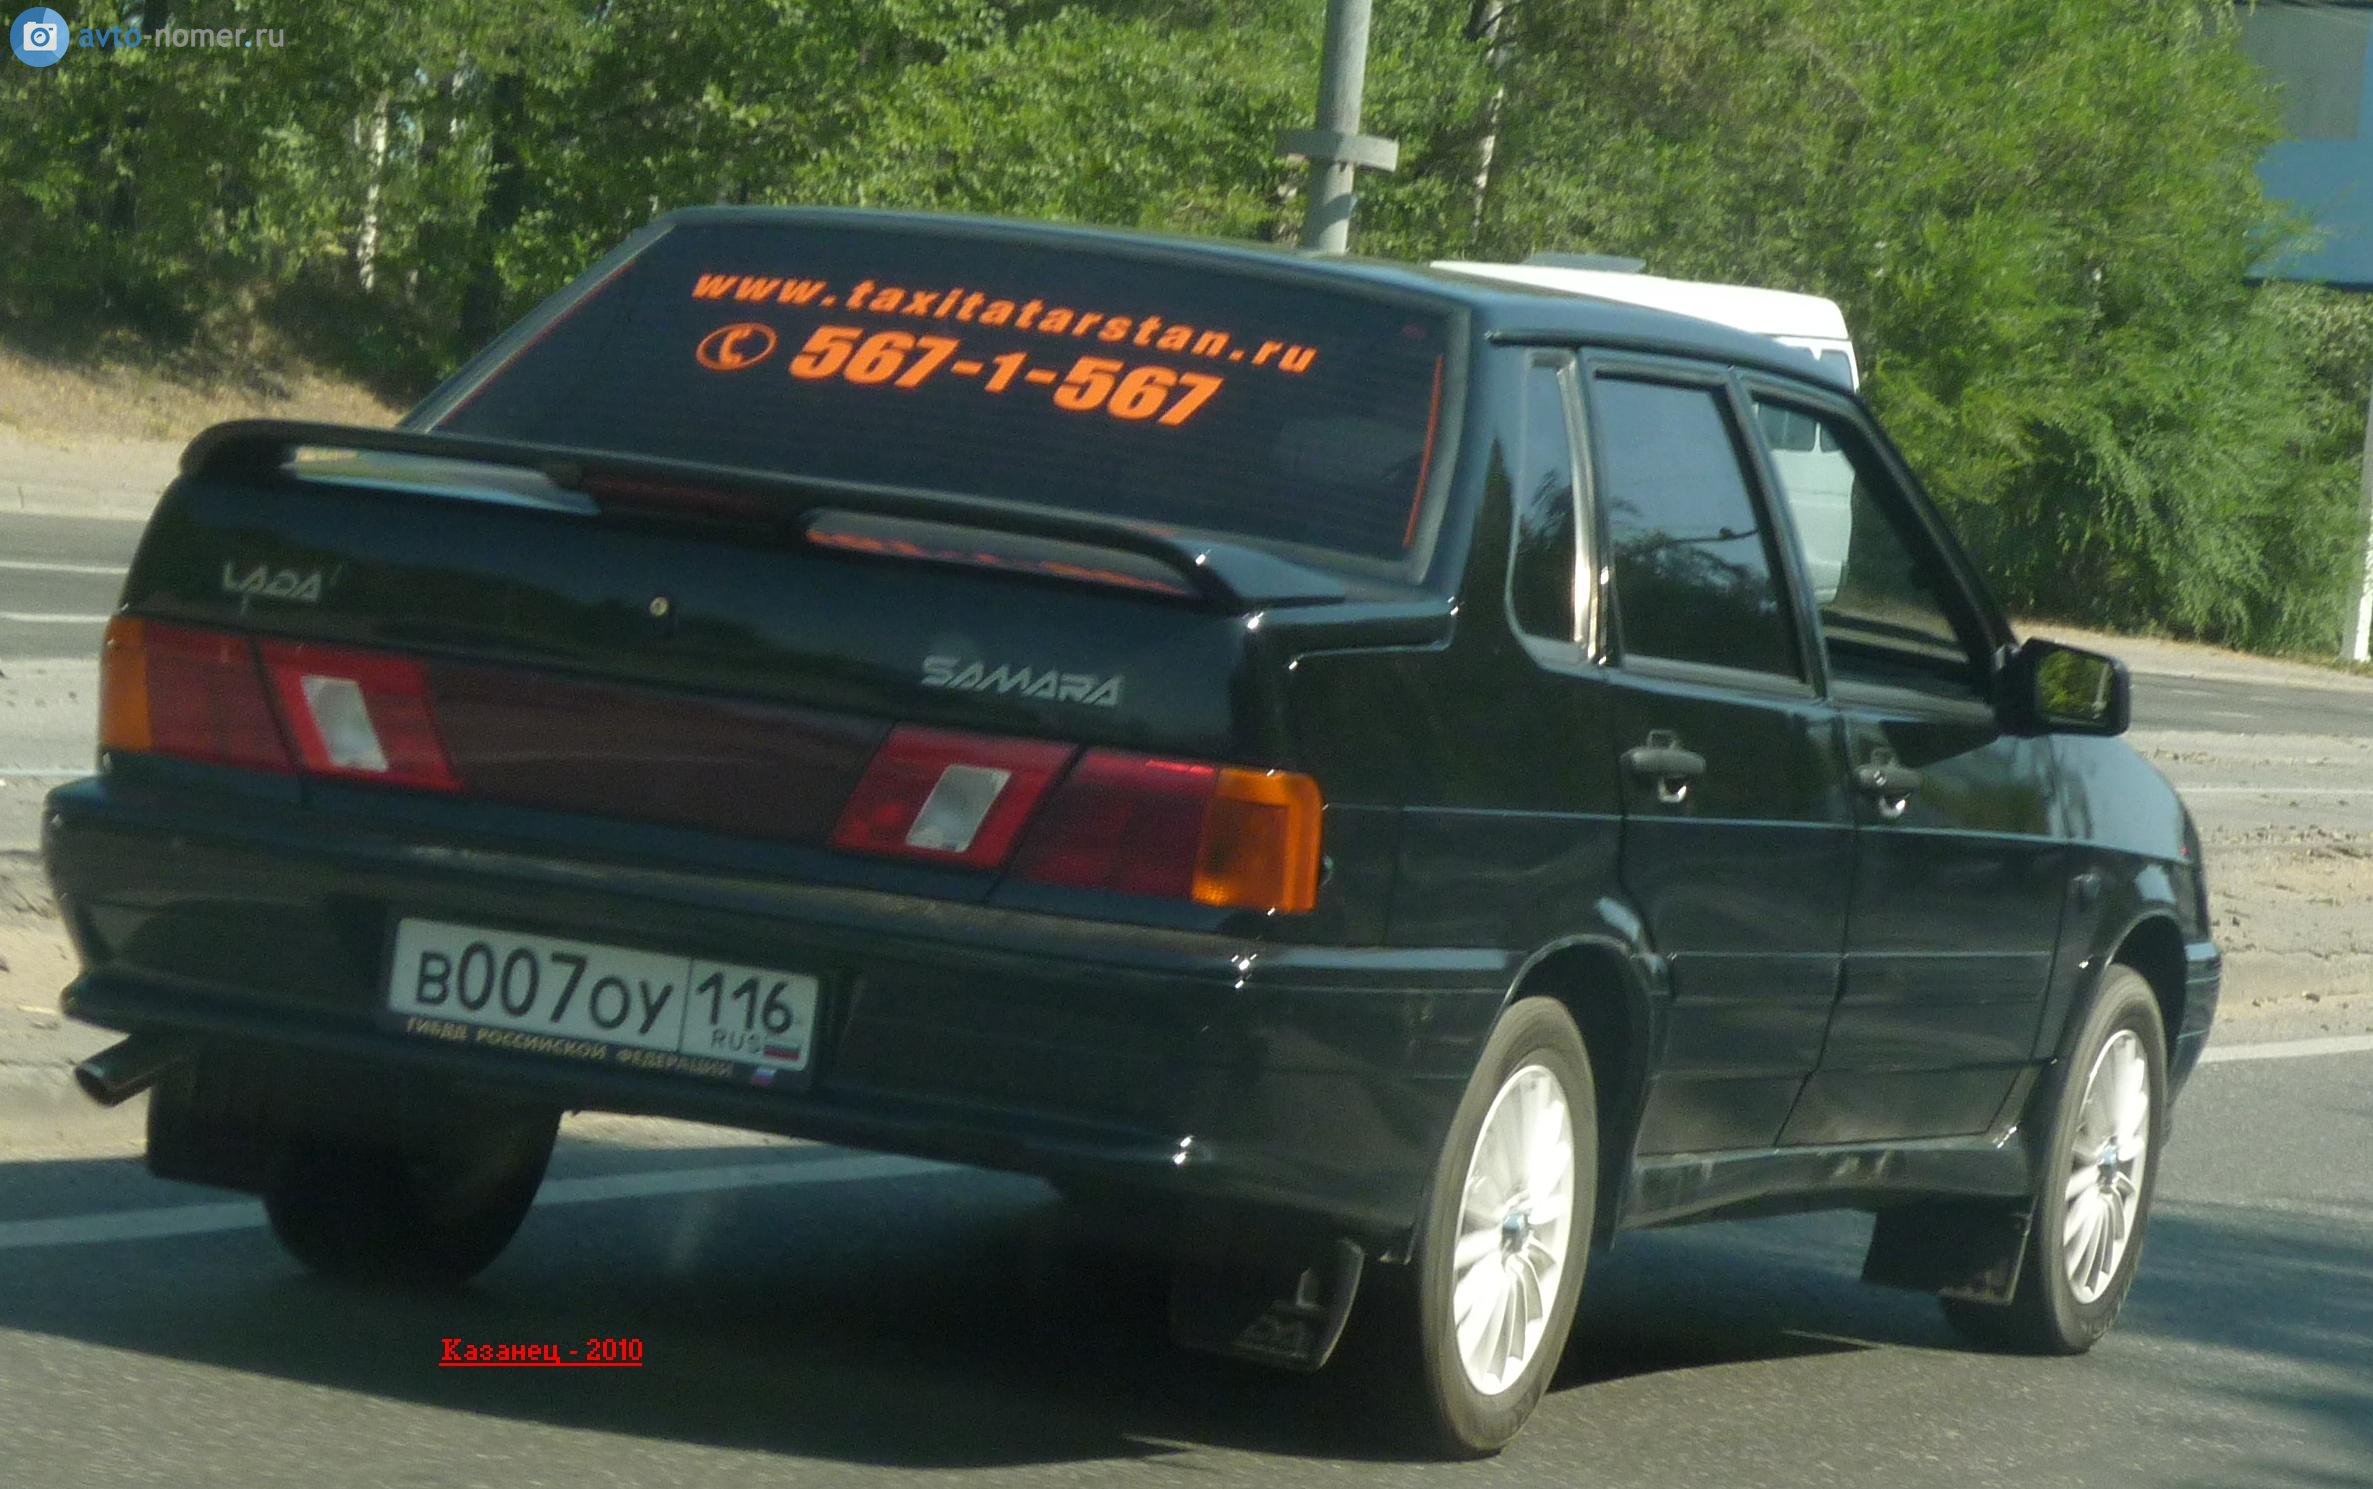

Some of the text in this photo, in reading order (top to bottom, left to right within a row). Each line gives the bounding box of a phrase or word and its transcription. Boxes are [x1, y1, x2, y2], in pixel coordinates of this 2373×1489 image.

[692, 273, 1318, 373] www.taxitatarstan.ru
[789, 324, 1224, 427] 567-1-567
[222, 561, 322, 603] LADA
[920, 655, 1125, 708] SAMARA
[696, 971, 793, 1035] 116
[710, 1028, 761, 1054] RUS
